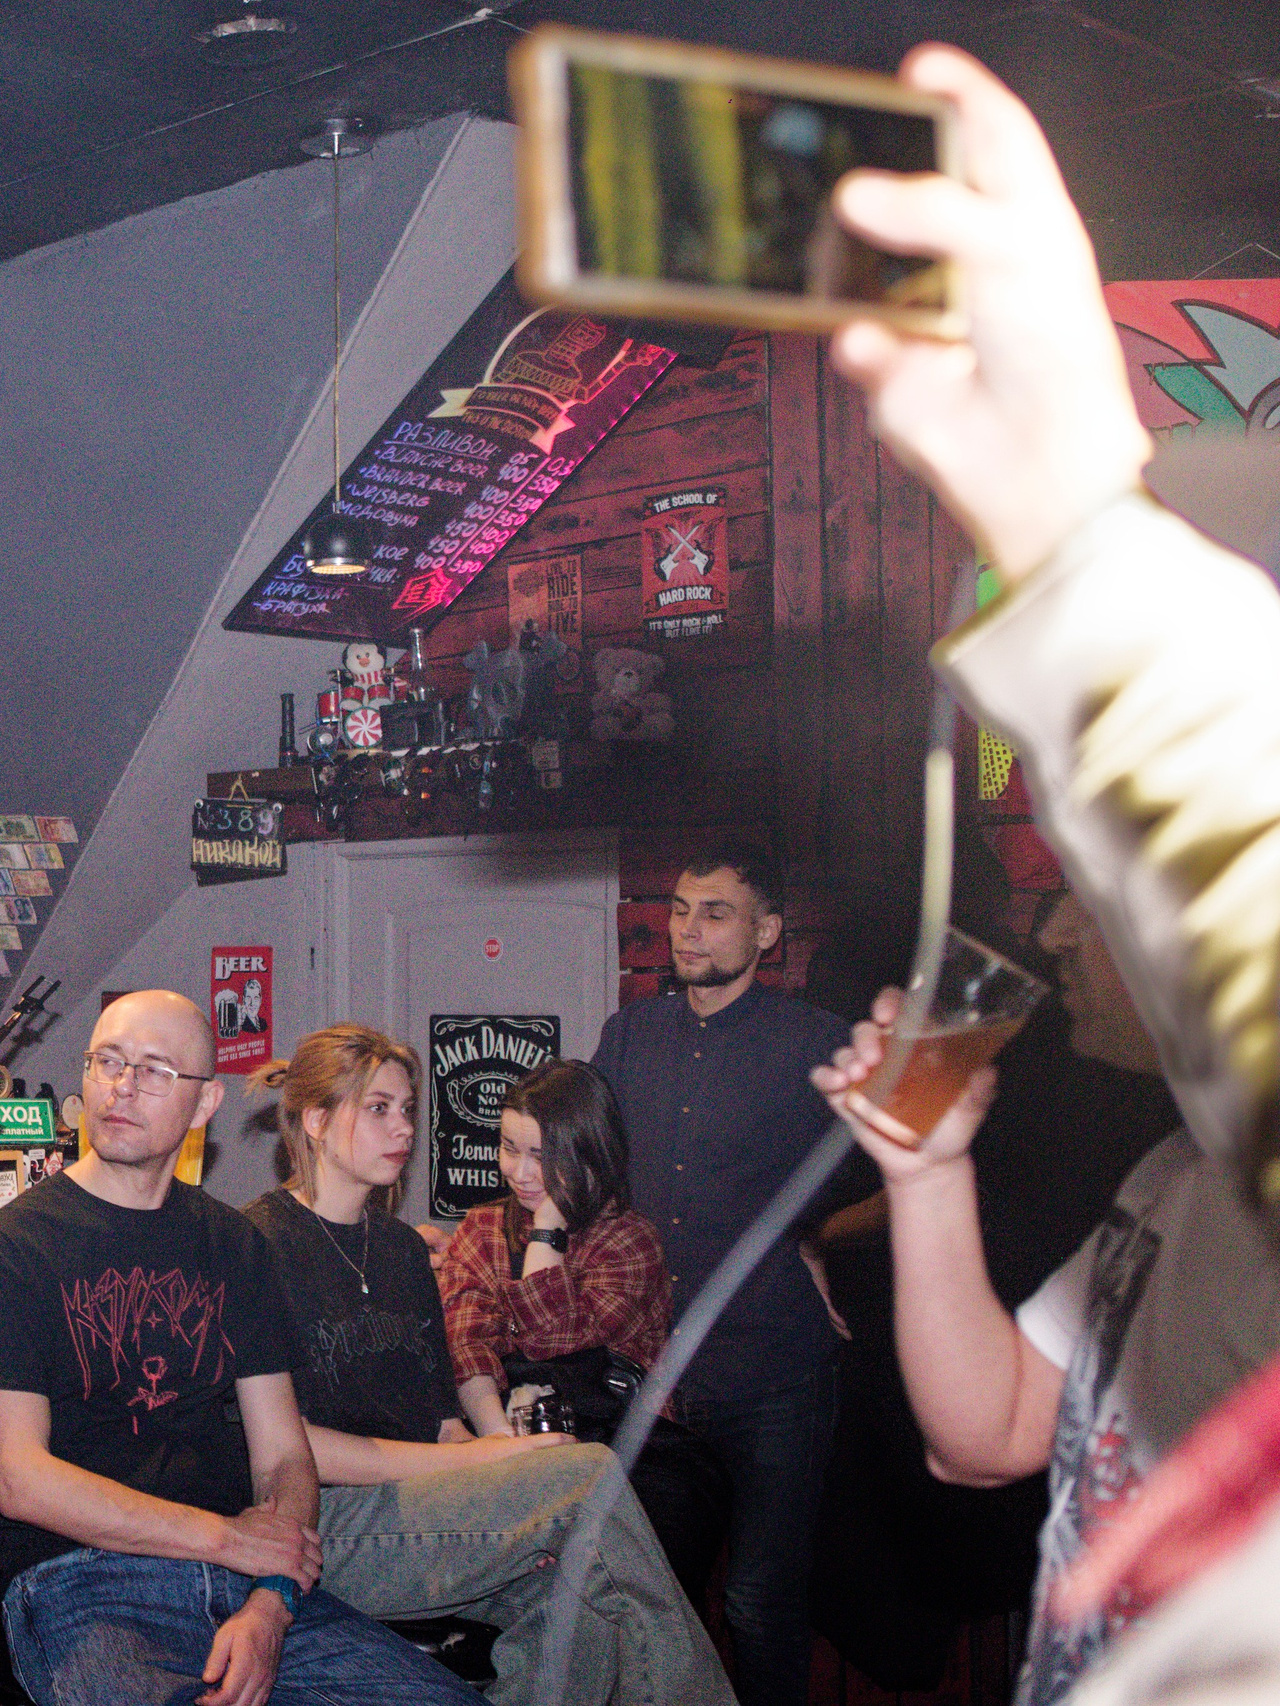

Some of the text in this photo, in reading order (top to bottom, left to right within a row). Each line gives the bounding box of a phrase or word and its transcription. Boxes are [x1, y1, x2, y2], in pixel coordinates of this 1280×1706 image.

[654, 493, 718, 512] THE SCHOOL OF
[658, 586, 712, 607] HARD ROCK
[214, 956, 269, 980] BEER
[434, 1035, 477, 1077] JACK
[479, 1082, 506, 1094] Old
[448, 1168, 504, 1187] WHIS
